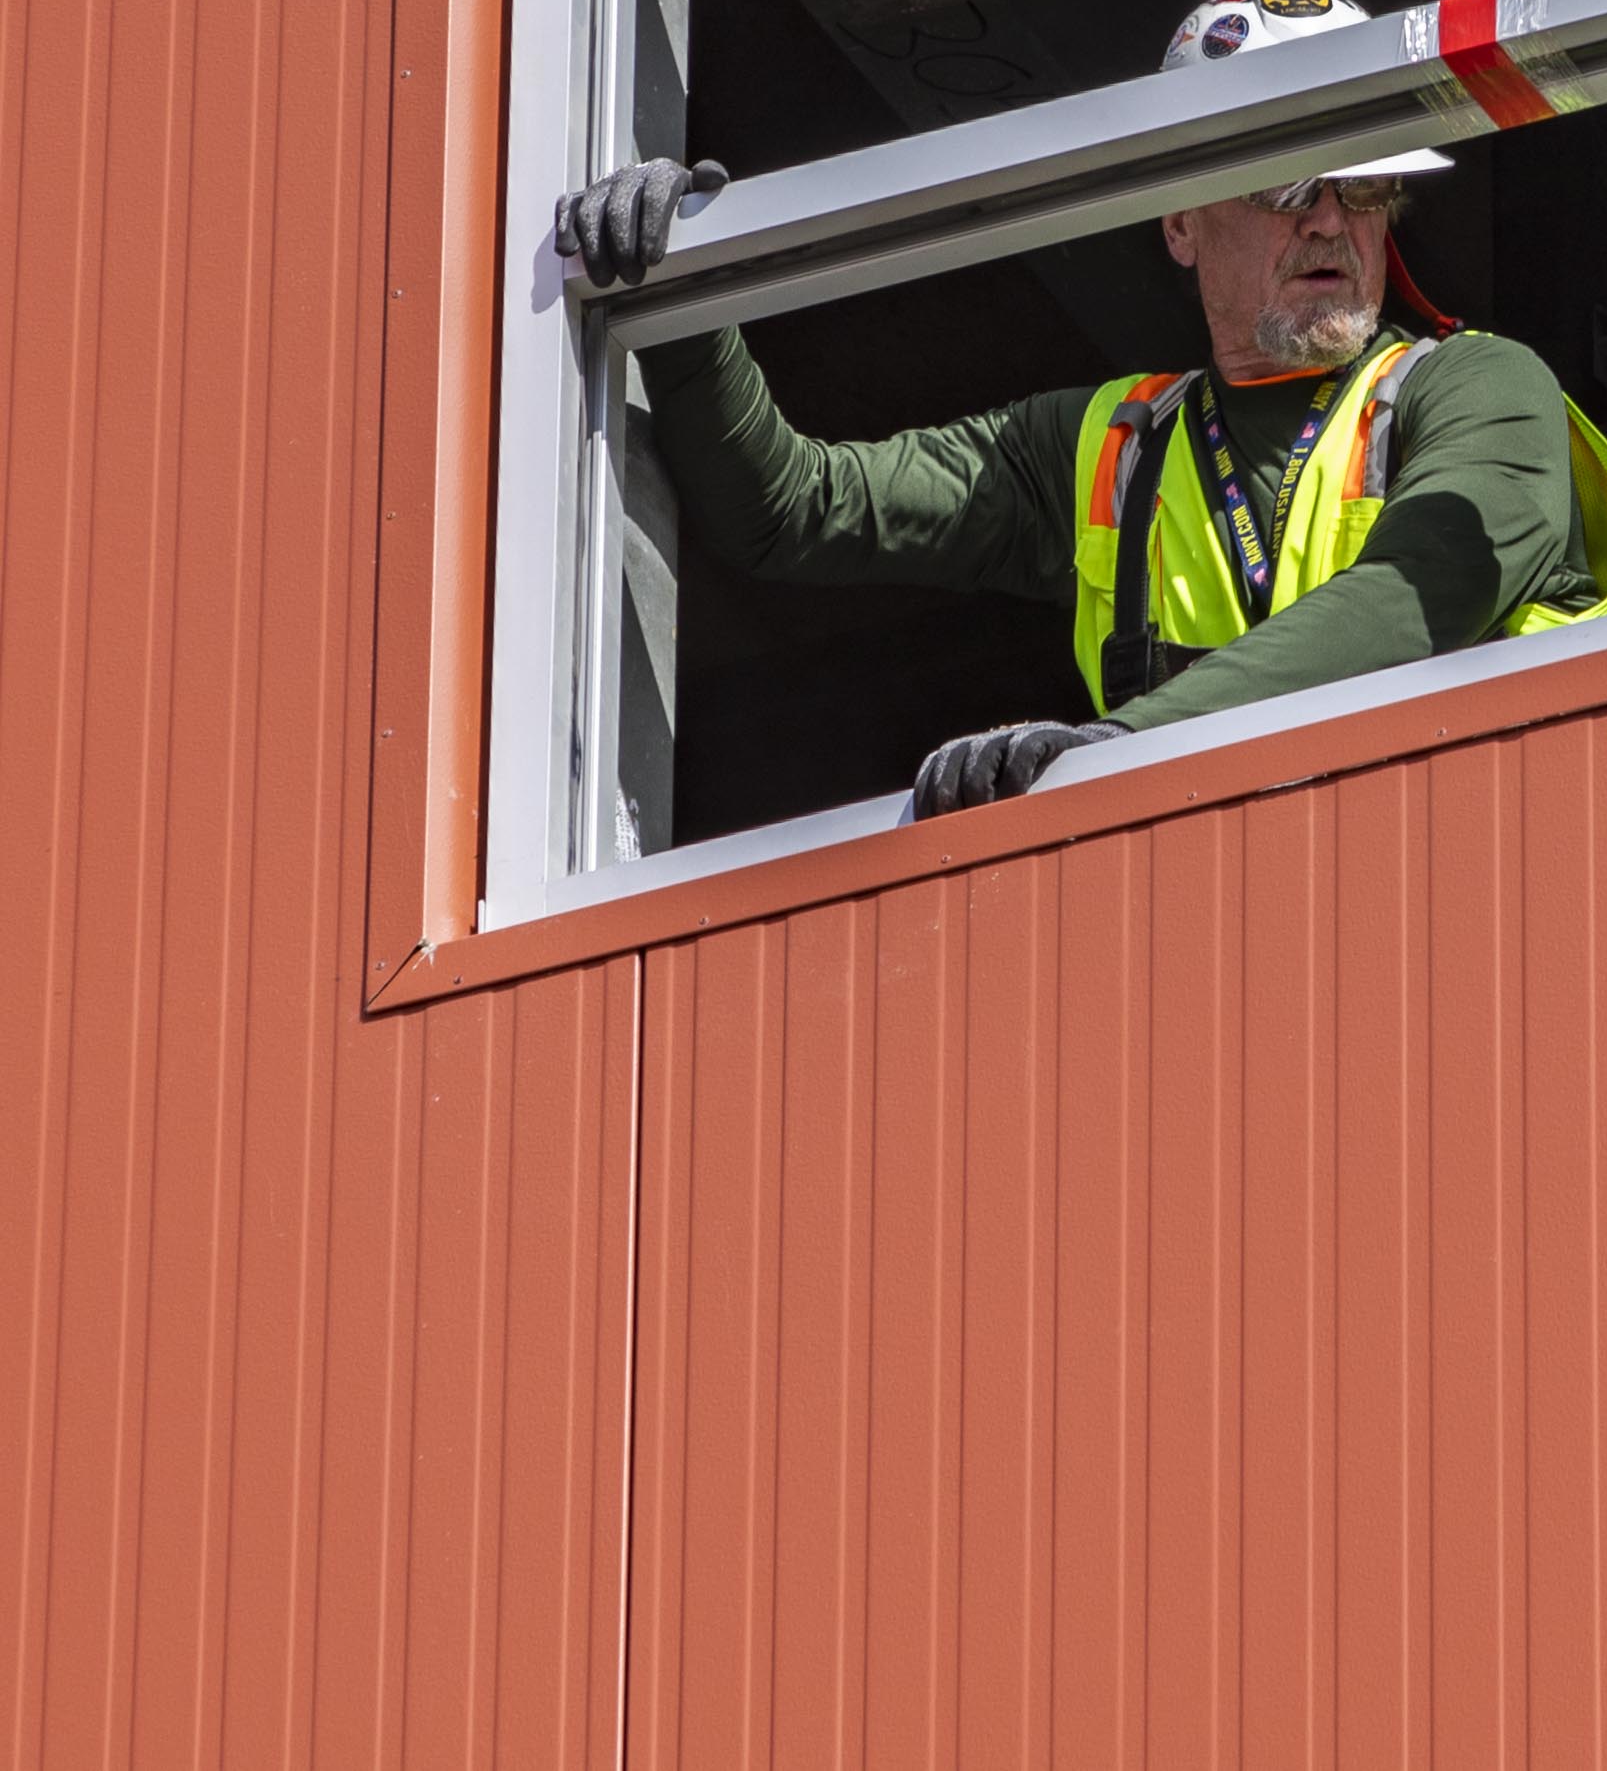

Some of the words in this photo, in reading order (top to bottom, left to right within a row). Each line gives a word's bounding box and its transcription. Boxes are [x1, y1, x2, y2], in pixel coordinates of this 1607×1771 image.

[836, 0, 1058, 121] 30
[1214, 445, 1235, 480] NAVY
[1232, 505, 1263, 566] NAVY.COM
